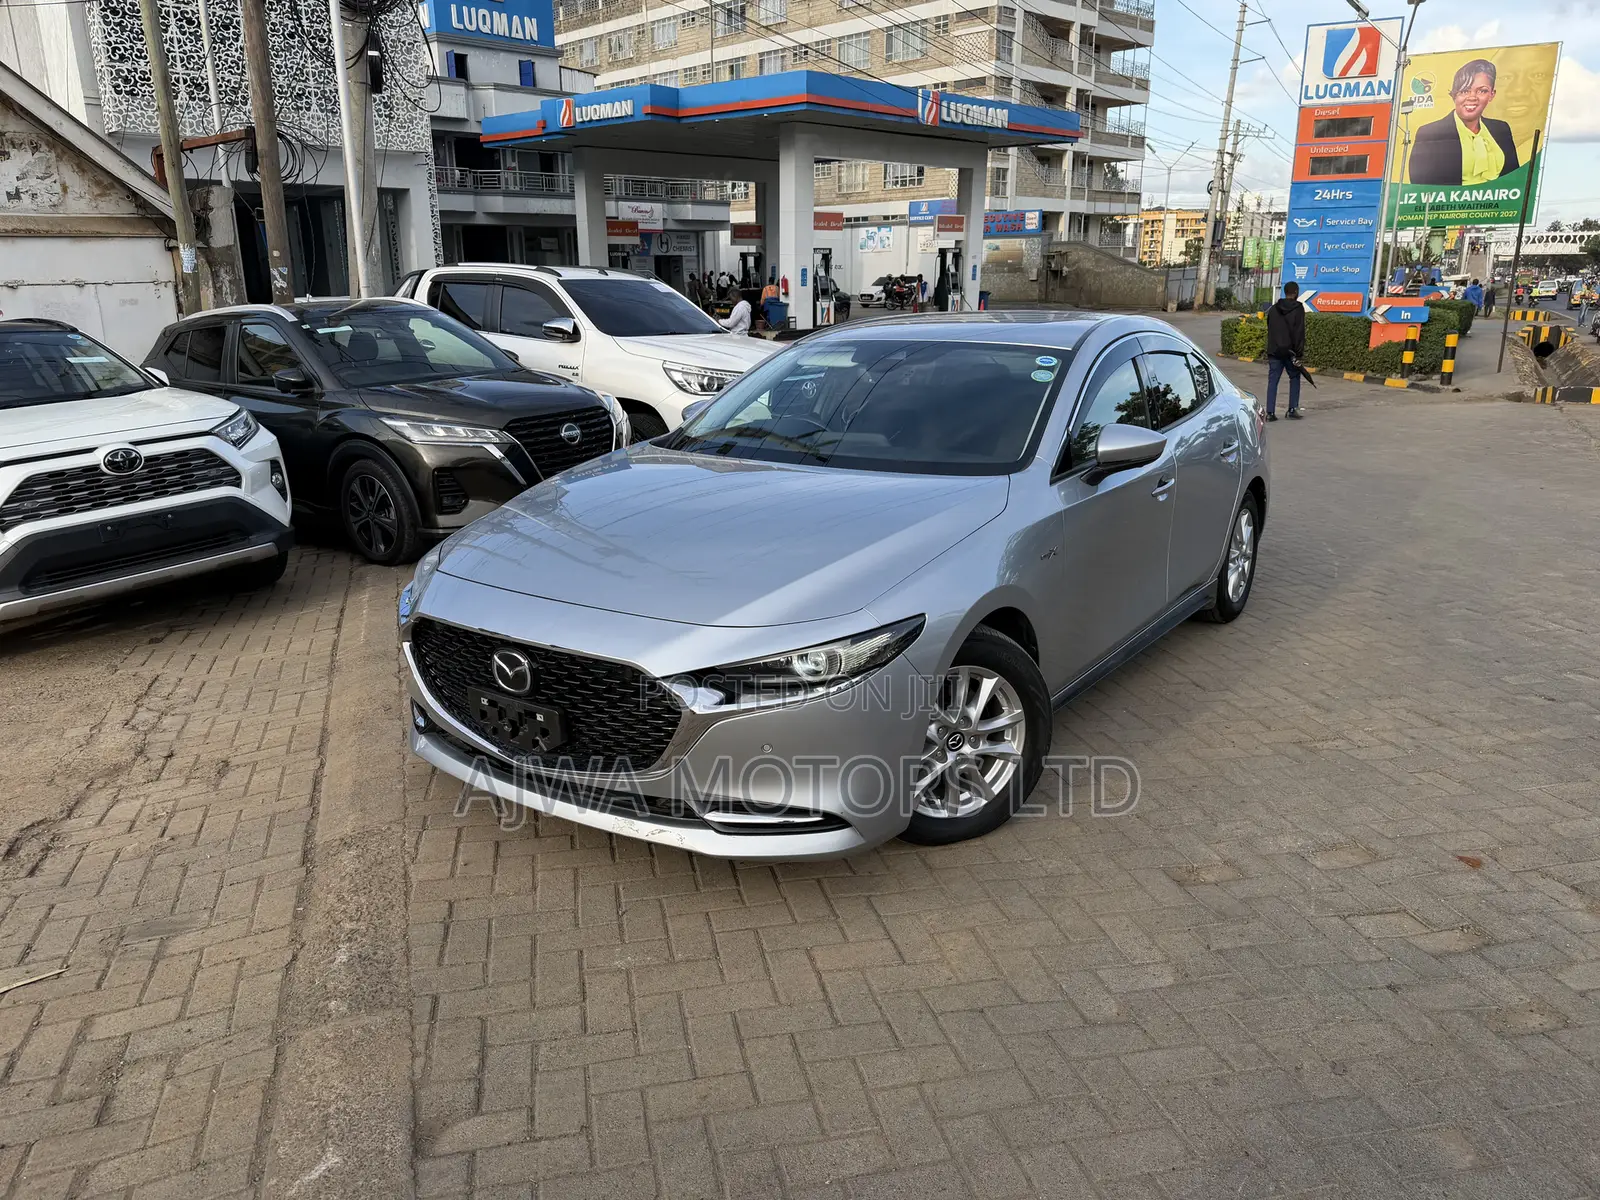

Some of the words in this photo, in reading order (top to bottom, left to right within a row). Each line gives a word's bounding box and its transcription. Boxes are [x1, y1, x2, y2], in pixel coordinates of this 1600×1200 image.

[450, 4, 538, 41] LUQMAN
[1303, 80, 1392, 100] LUQMAN
[575, 99, 634, 122] LUQMAN
[941, 100, 1009, 129] LUQMAN
[1314, 108, 1340, 116] Diesel
[1310, 145, 1349, 154] Unleaded
[1314, 189, 1353, 200] 24Hrs
[1420, 191, 1447, 203] WA
[1449, 188, 1521, 202] KANAIRO
[1414, 204, 1456, 212] ELIABETH
[1457, 202, 1499, 210] WAITHIRA
[984, 211, 1025, 223] ECUTIVE
[1326, 218, 1356, 226] Service
[1358, 217, 1374, 227] Bay
[996, 223, 1023, 233] WASH
[1324, 242, 1340, 251] Tyre
[1341, 242, 1365, 250] Center
[1320, 265, 1339, 273] Quick
[1342, 265, 1360, 274] Shop
[1316, 298, 1359, 306] Restaurant
[1401, 311, 1411, 320] In
